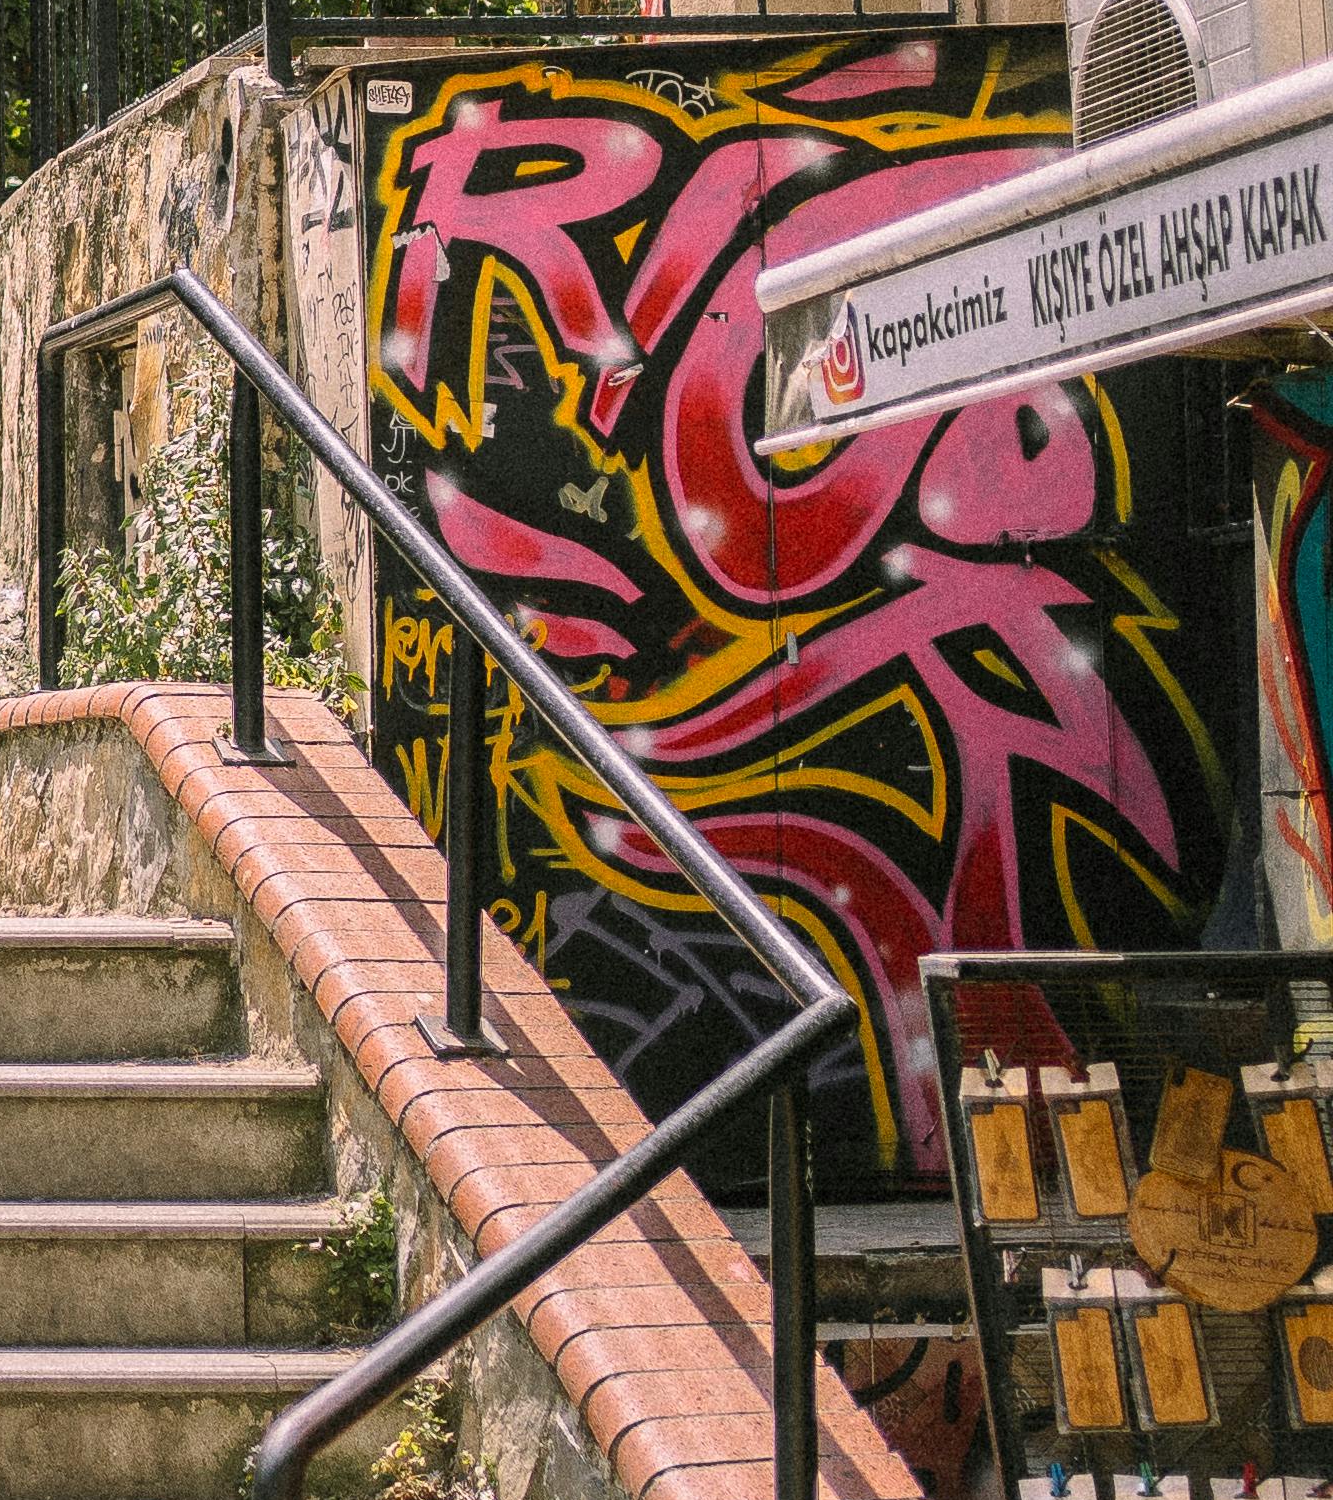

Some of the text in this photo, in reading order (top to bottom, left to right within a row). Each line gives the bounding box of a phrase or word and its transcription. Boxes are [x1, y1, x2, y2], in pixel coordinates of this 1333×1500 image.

[1027, 164, 1329, 343] KİŞİYE ÖZEL AHŞAP KAPAK
[866, 276, 1006, 366] kapakcimiz
